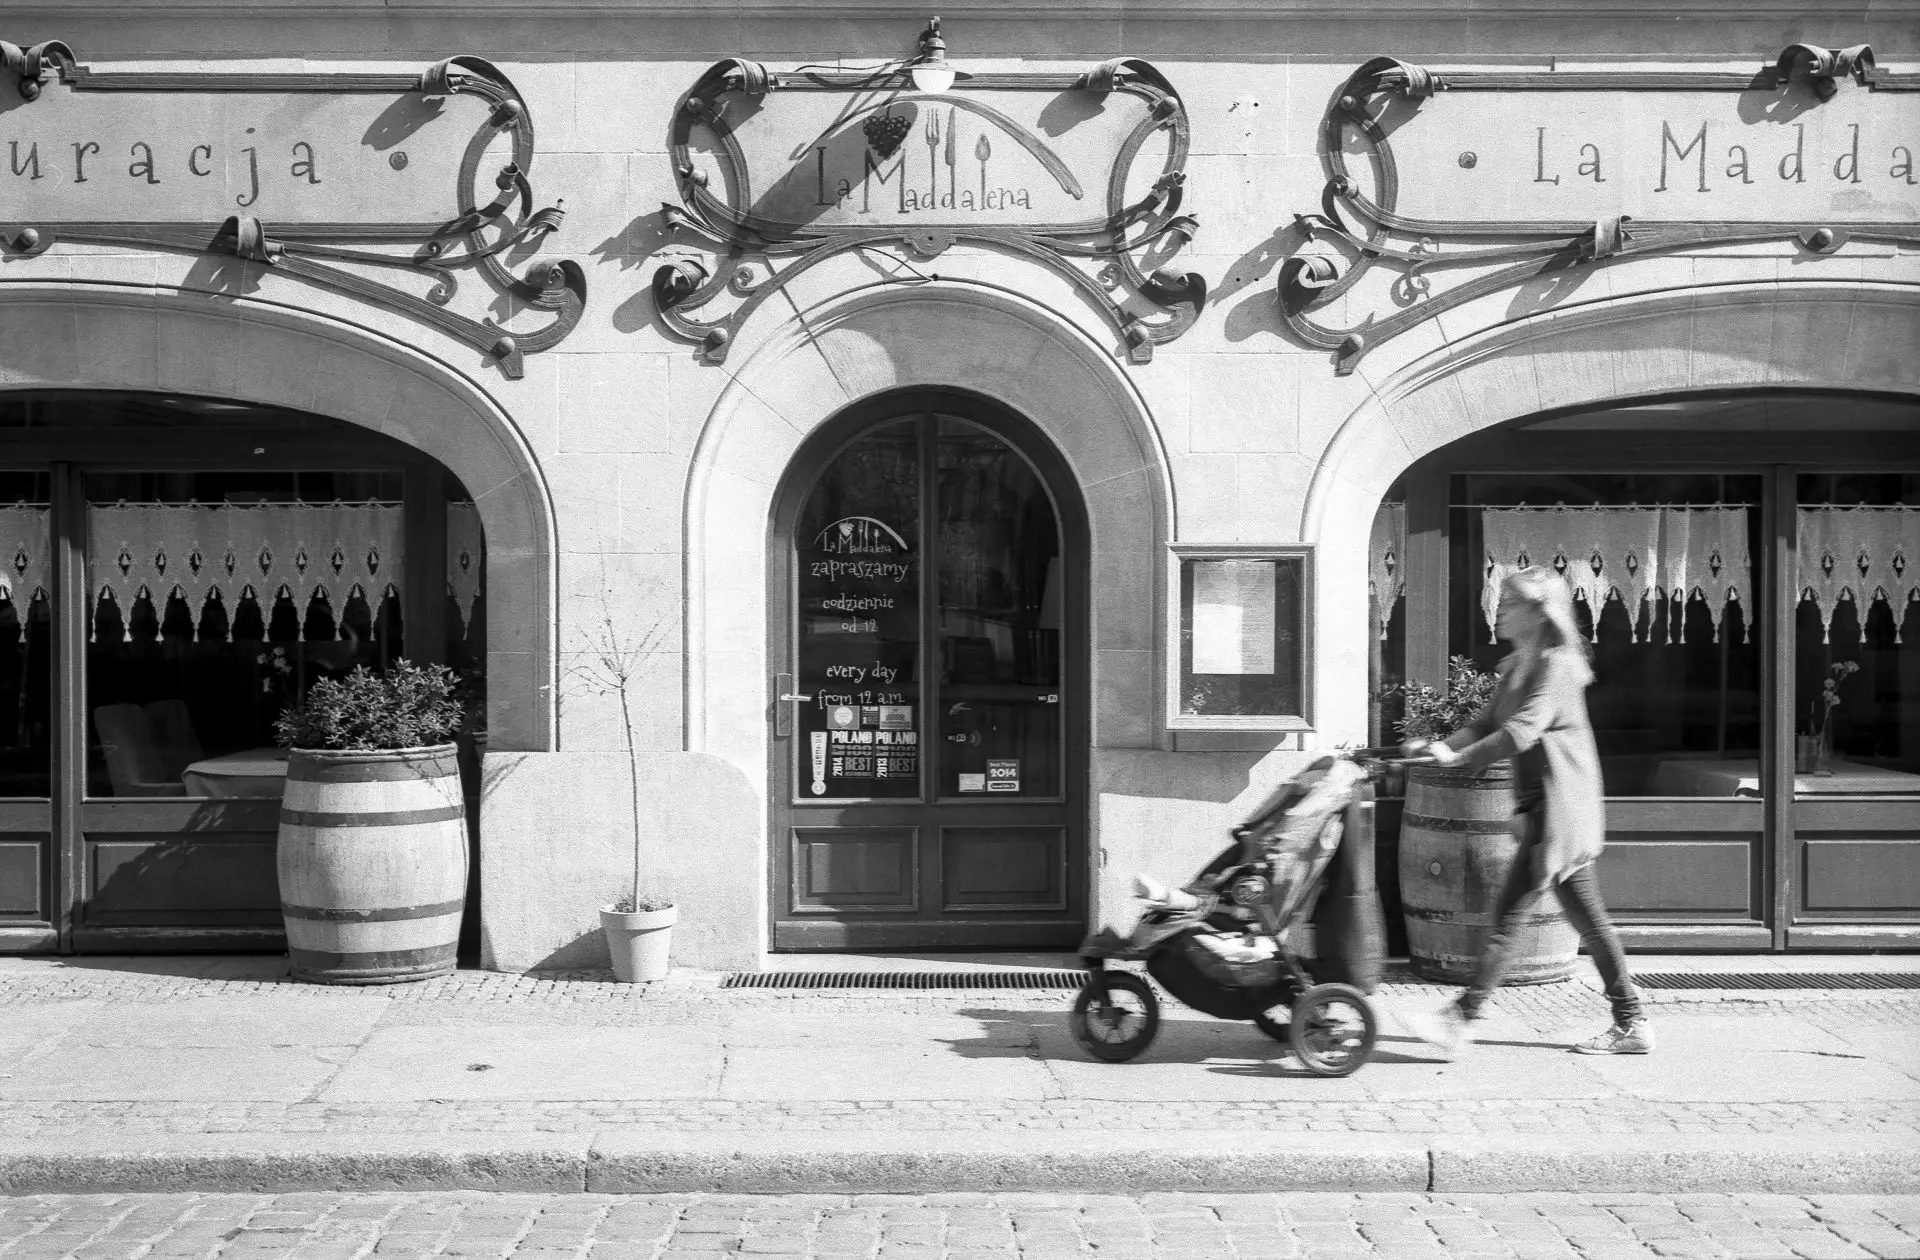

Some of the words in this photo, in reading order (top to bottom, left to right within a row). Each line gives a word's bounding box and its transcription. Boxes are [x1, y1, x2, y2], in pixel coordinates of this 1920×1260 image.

[815, 147, 853, 208] La
[858, 112, 1033, 214] Maddalena
[1533, 126, 1606, 186] La
[1654, 119, 1919, 193] Madda
[9, 127, 321, 207] uracja
[823, 532, 836, 552] La
[837, 524, 892, 554] Maddalena
[811, 560, 908, 583] zapraszamy
[823, 593, 895, 612] codziennie
[841, 616, 858, 634] od
[861, 619, 878, 633] 12
[826, 665, 867, 684] every
[871, 661, 898, 684] day
[818, 689, 854, 710] from
[857, 690, 872, 704] 12
[832, 730, 873, 744] POLAND
[875, 731, 917, 745] POLAND
[832, 757, 843, 777] 2014
[845, 757, 873, 771] BEST
[876, 757, 888, 778] 2013
[889, 758, 917, 772] BEST
[989, 768, 1017, 778] 2014
